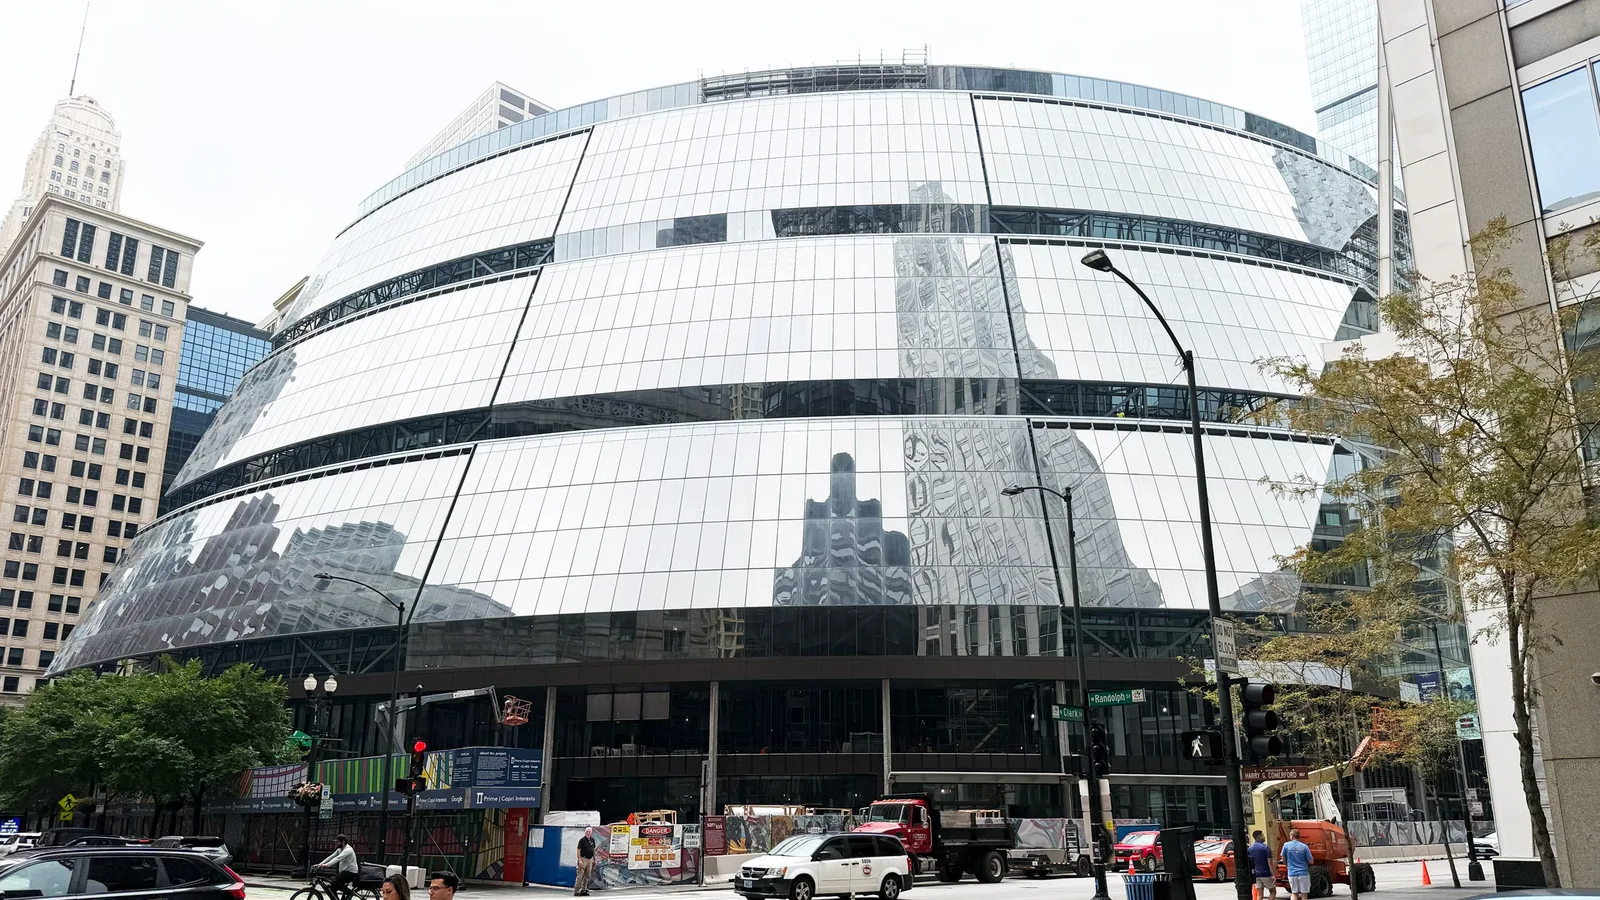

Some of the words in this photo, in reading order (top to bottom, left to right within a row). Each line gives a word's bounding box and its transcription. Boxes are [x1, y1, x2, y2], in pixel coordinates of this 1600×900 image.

[1216, 624, 1223, 636] DO
[1223, 625, 1233, 638] NOT
[1218, 640, 1236, 655] BLOCK
[1095, 693, 1126, 704] Randolph
[1063, 707, 1079, 718] Clark
